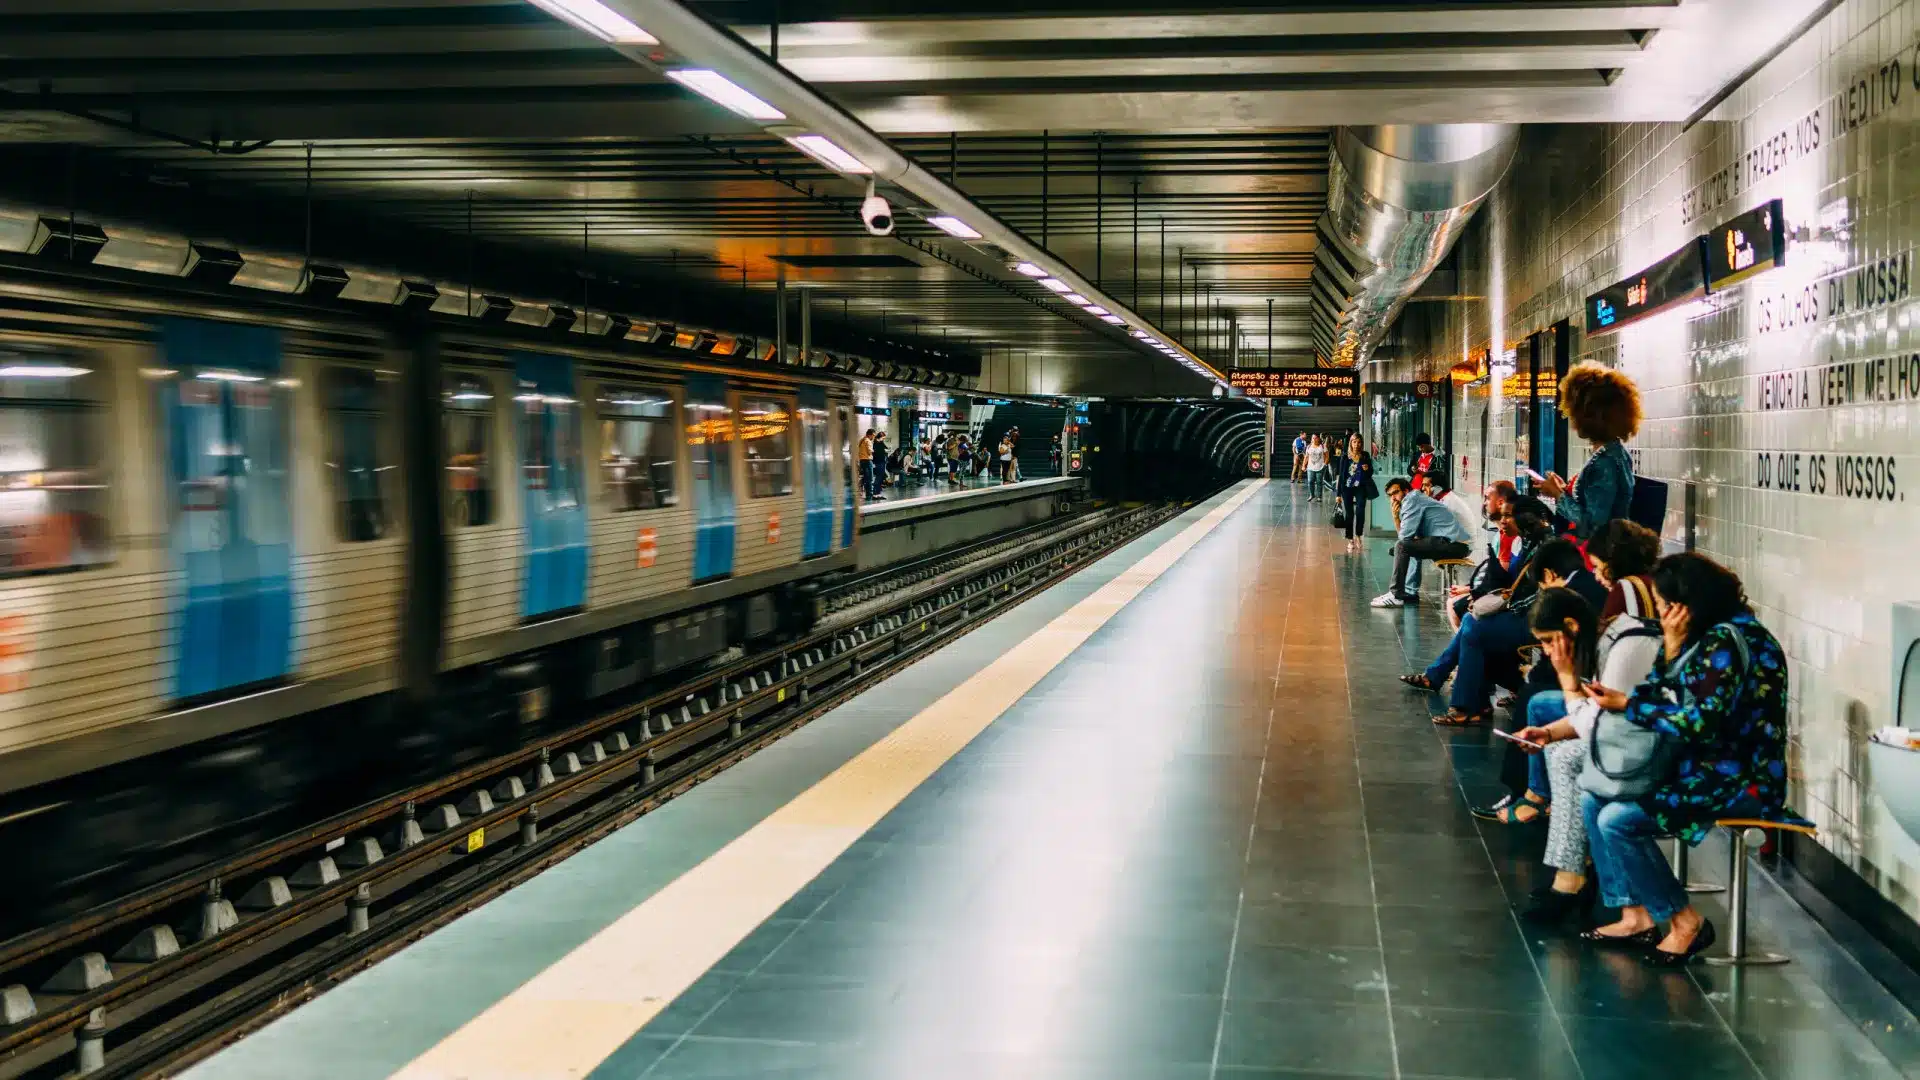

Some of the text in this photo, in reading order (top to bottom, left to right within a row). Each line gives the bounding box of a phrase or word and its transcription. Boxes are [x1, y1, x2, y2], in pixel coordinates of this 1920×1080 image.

[1832, 59, 1900, 138] INÉDITO
[1828, 278, 1846, 317] DA
[1856, 255, 1908, 310] NOSSA
[1284, 372, 1327, 380] intervalo
[1328, 376, 1353, 384] 20:04
[1818, 355, 1855, 406] VÊEM
[1757, 452, 1904, 502] DO QUE OS NOSSOS.
